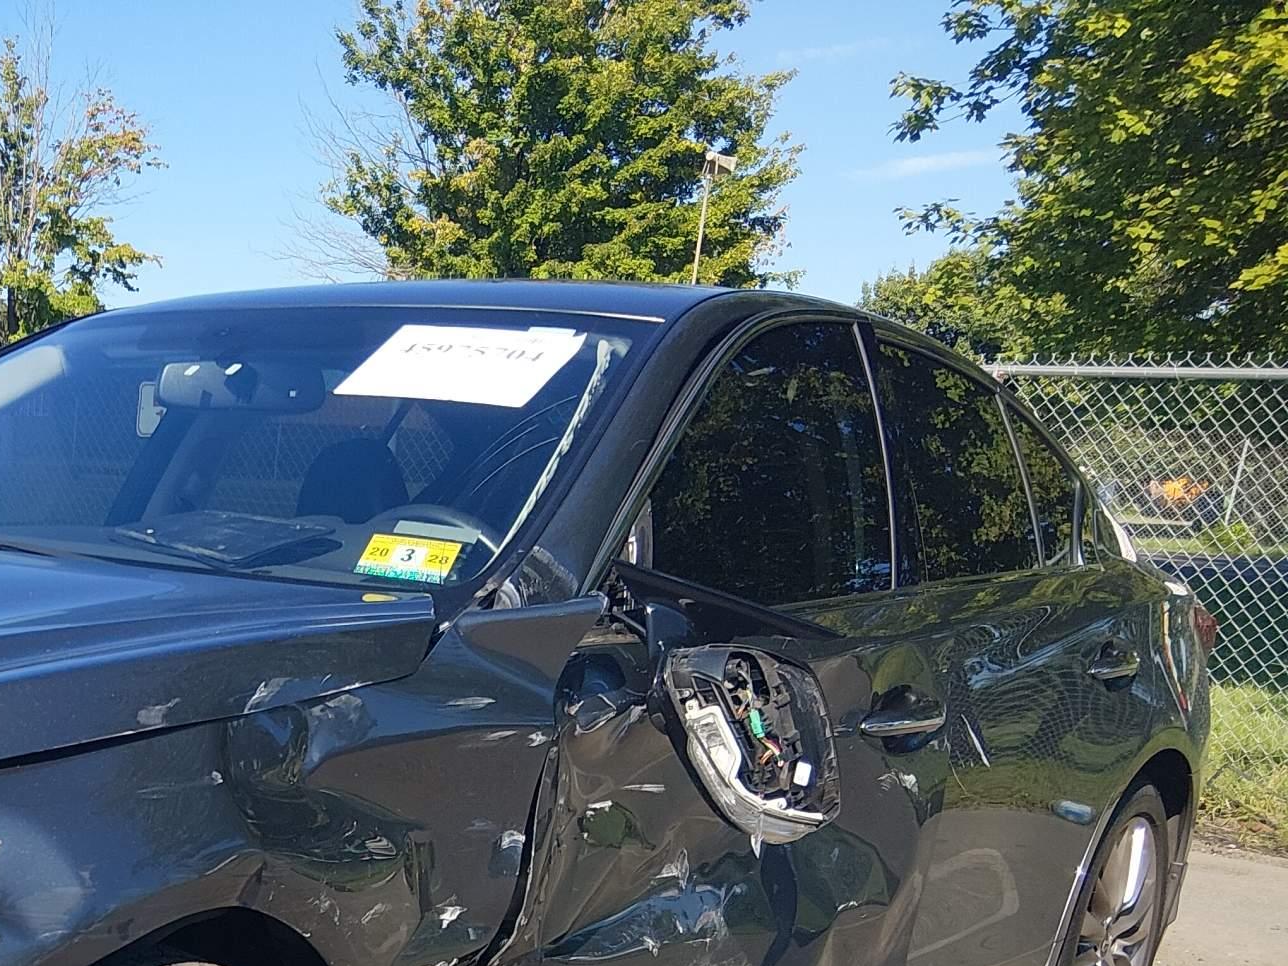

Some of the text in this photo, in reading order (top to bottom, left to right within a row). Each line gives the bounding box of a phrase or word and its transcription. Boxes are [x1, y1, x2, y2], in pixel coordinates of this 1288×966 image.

[369, 547, 449, 564] 20 3 28
